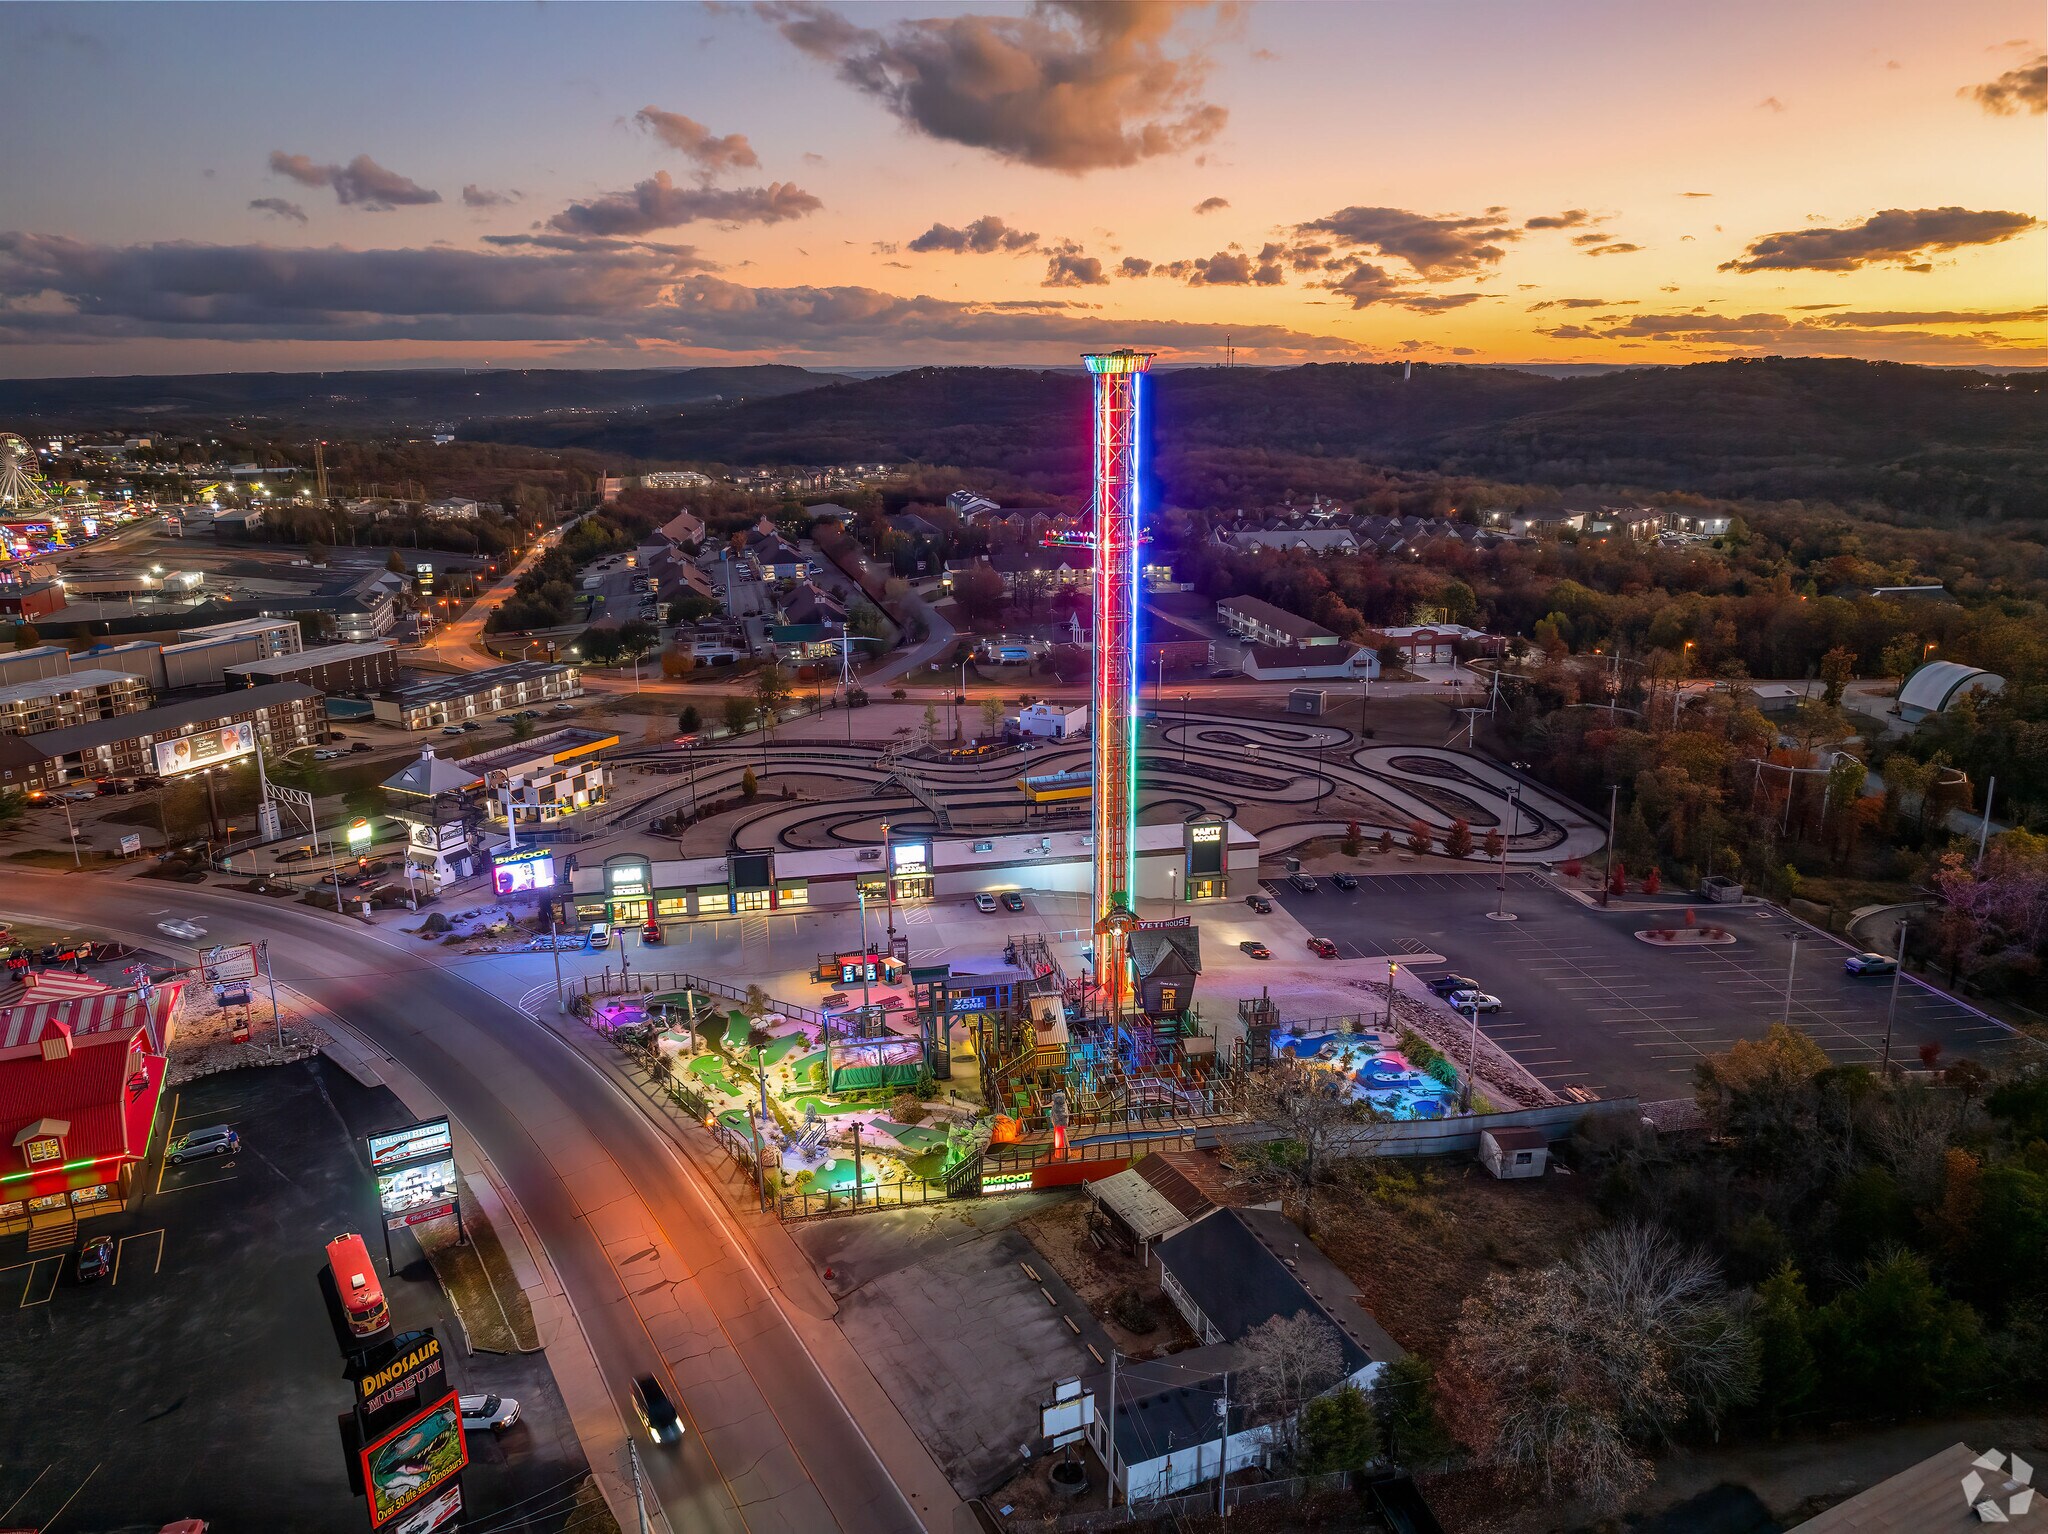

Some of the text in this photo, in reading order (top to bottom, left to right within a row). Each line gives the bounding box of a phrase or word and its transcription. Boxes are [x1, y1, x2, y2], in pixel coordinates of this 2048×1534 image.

[1193, 826, 1221, 836] PARTY
[1193, 834, 1220, 842] ROOMS
[495, 848, 551, 864] BIGFOOT
[895, 865, 926, 875] ARCADE
[1165, 917, 1189, 927] HOUSE
[375, 1126, 445, 1146] National BB Gun
[982, 1172, 1033, 1185] BIGFOOT
[982, 1184, 1005, 1193] AHEAD
[1016, 1181, 1033, 1190] FEET
[362, 1339, 440, 1397] DINOSAUR
[367, 1359, 442, 1415] MUSEUM
[377, 1504, 395, 1522] Over
[395, 1497, 406, 1511] 50
[431, 1453, 465, 1485] Dinosaurs!
